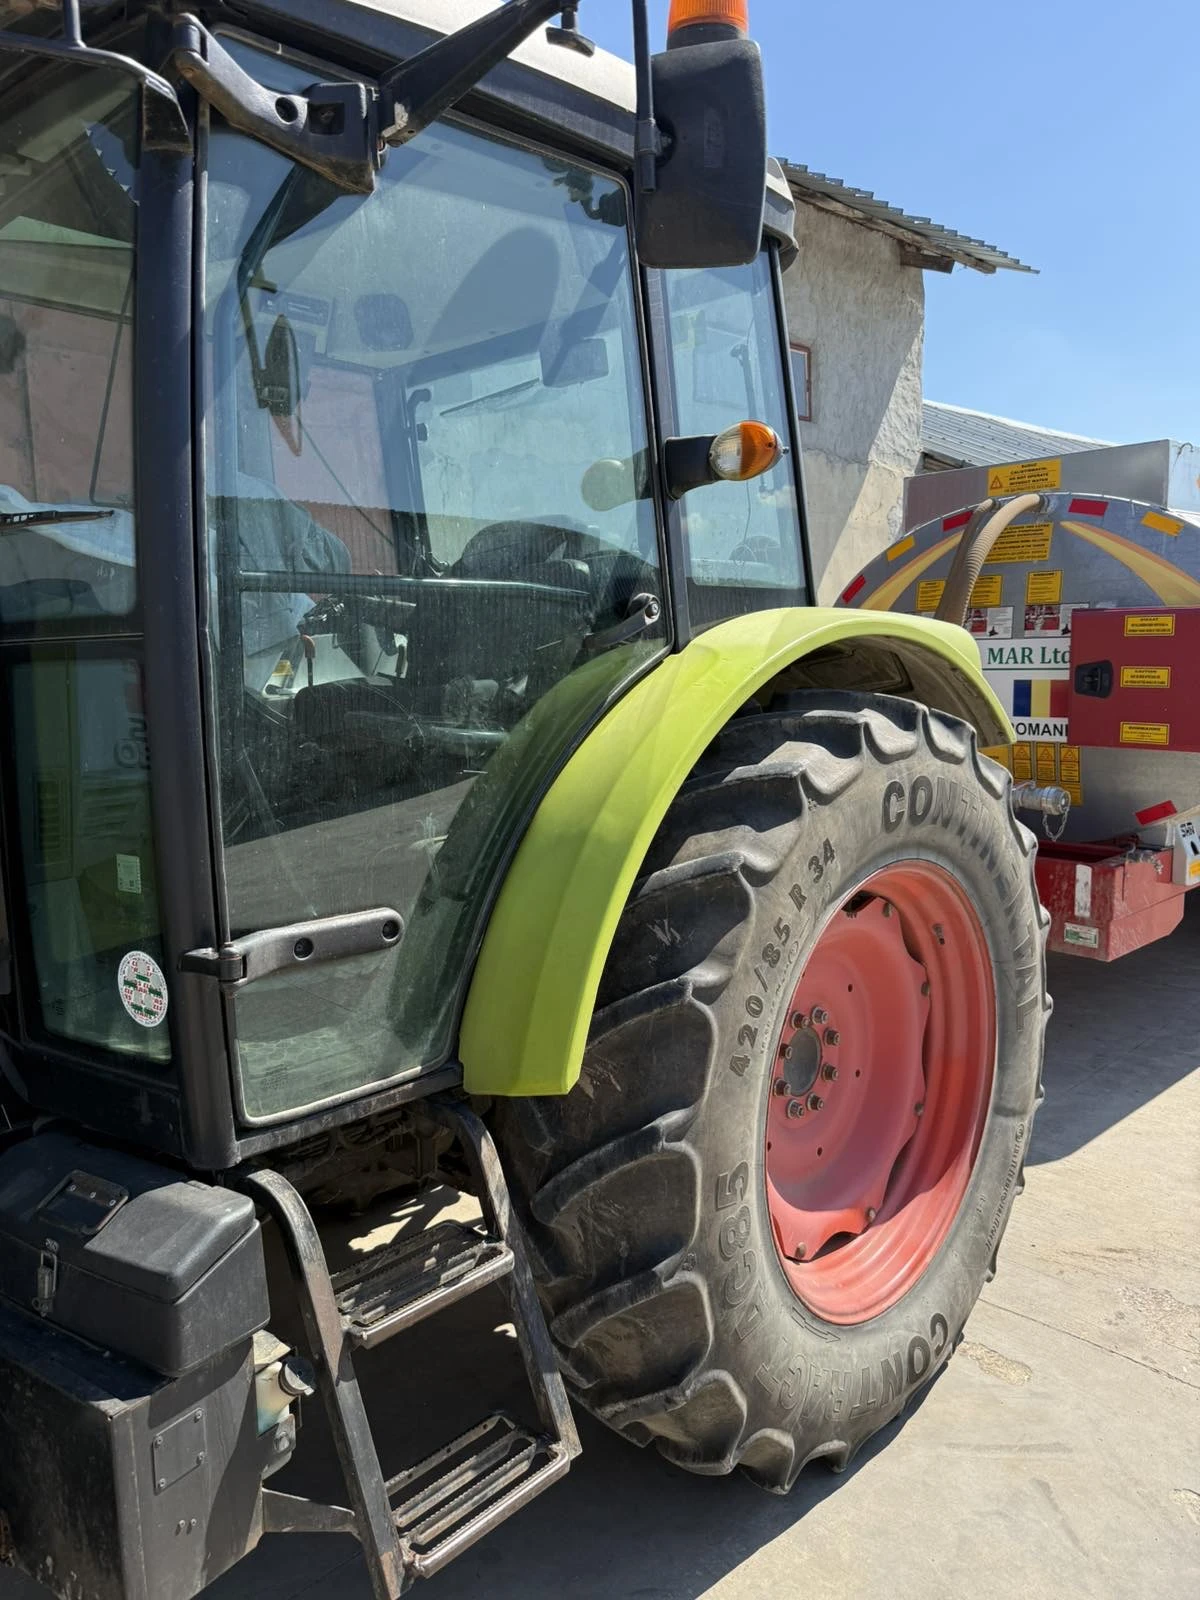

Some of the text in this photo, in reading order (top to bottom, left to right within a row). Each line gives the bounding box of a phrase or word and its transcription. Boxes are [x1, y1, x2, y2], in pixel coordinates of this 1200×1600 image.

[987, 646, 1034, 665] MAR
[1011, 722, 1069, 737] OMANI
[729, 917, 791, 1077] 420/85
[788, 882, 807, 913] R
[808, 837, 836, 884] 34
